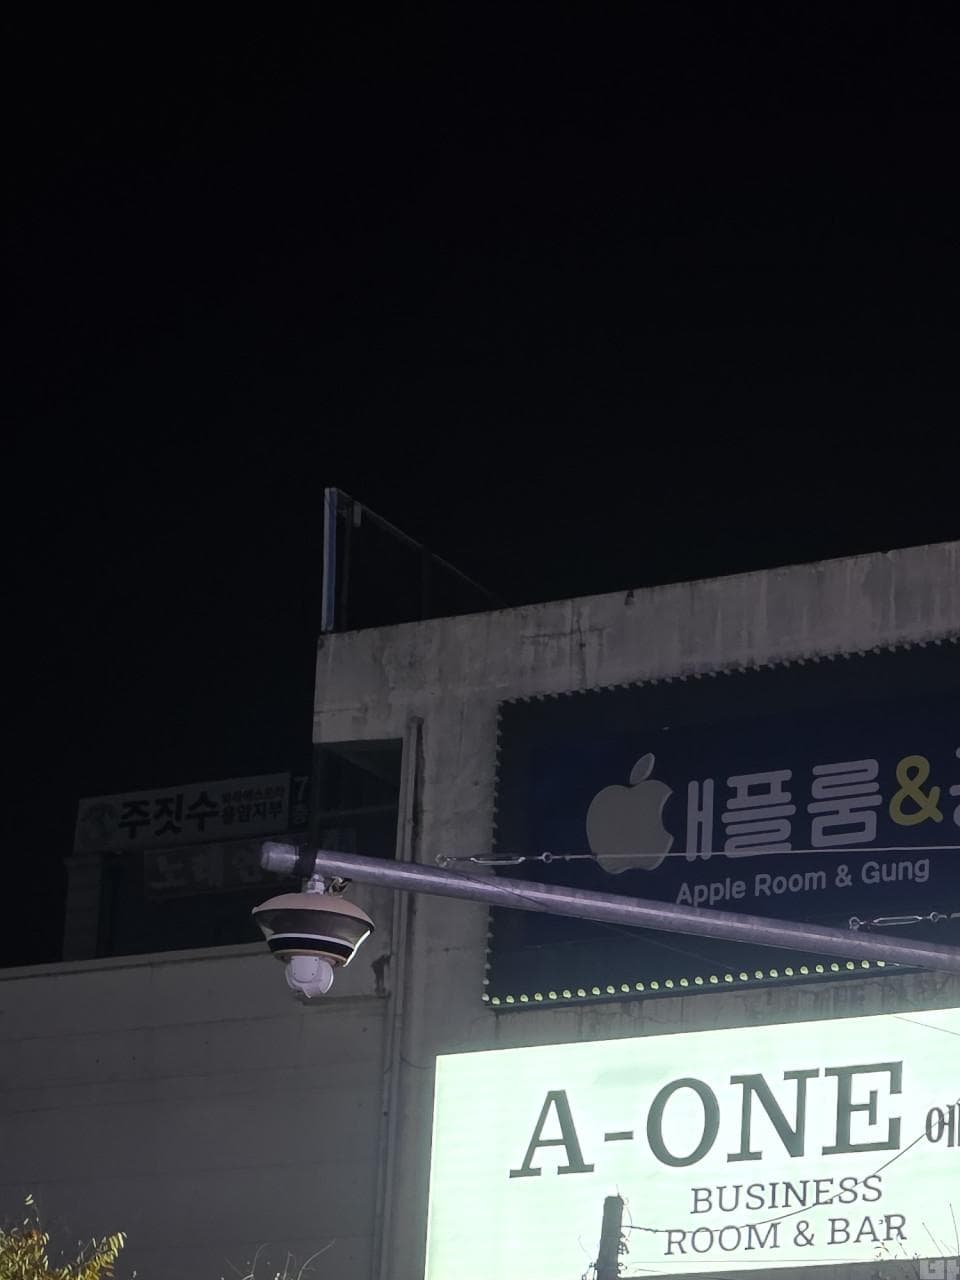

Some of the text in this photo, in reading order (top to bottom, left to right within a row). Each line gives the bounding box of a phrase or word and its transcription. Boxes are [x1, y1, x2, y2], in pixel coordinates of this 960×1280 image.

[119, 791, 220, 839] 주짓수
[675, 857, 931, 908] Apple Room & Gung
[509, 1060, 903, 1179] A-ONE
[690, 1174, 883, 1214] BUSINESS
[663, 1212, 908, 1256] ROOM & BAR
